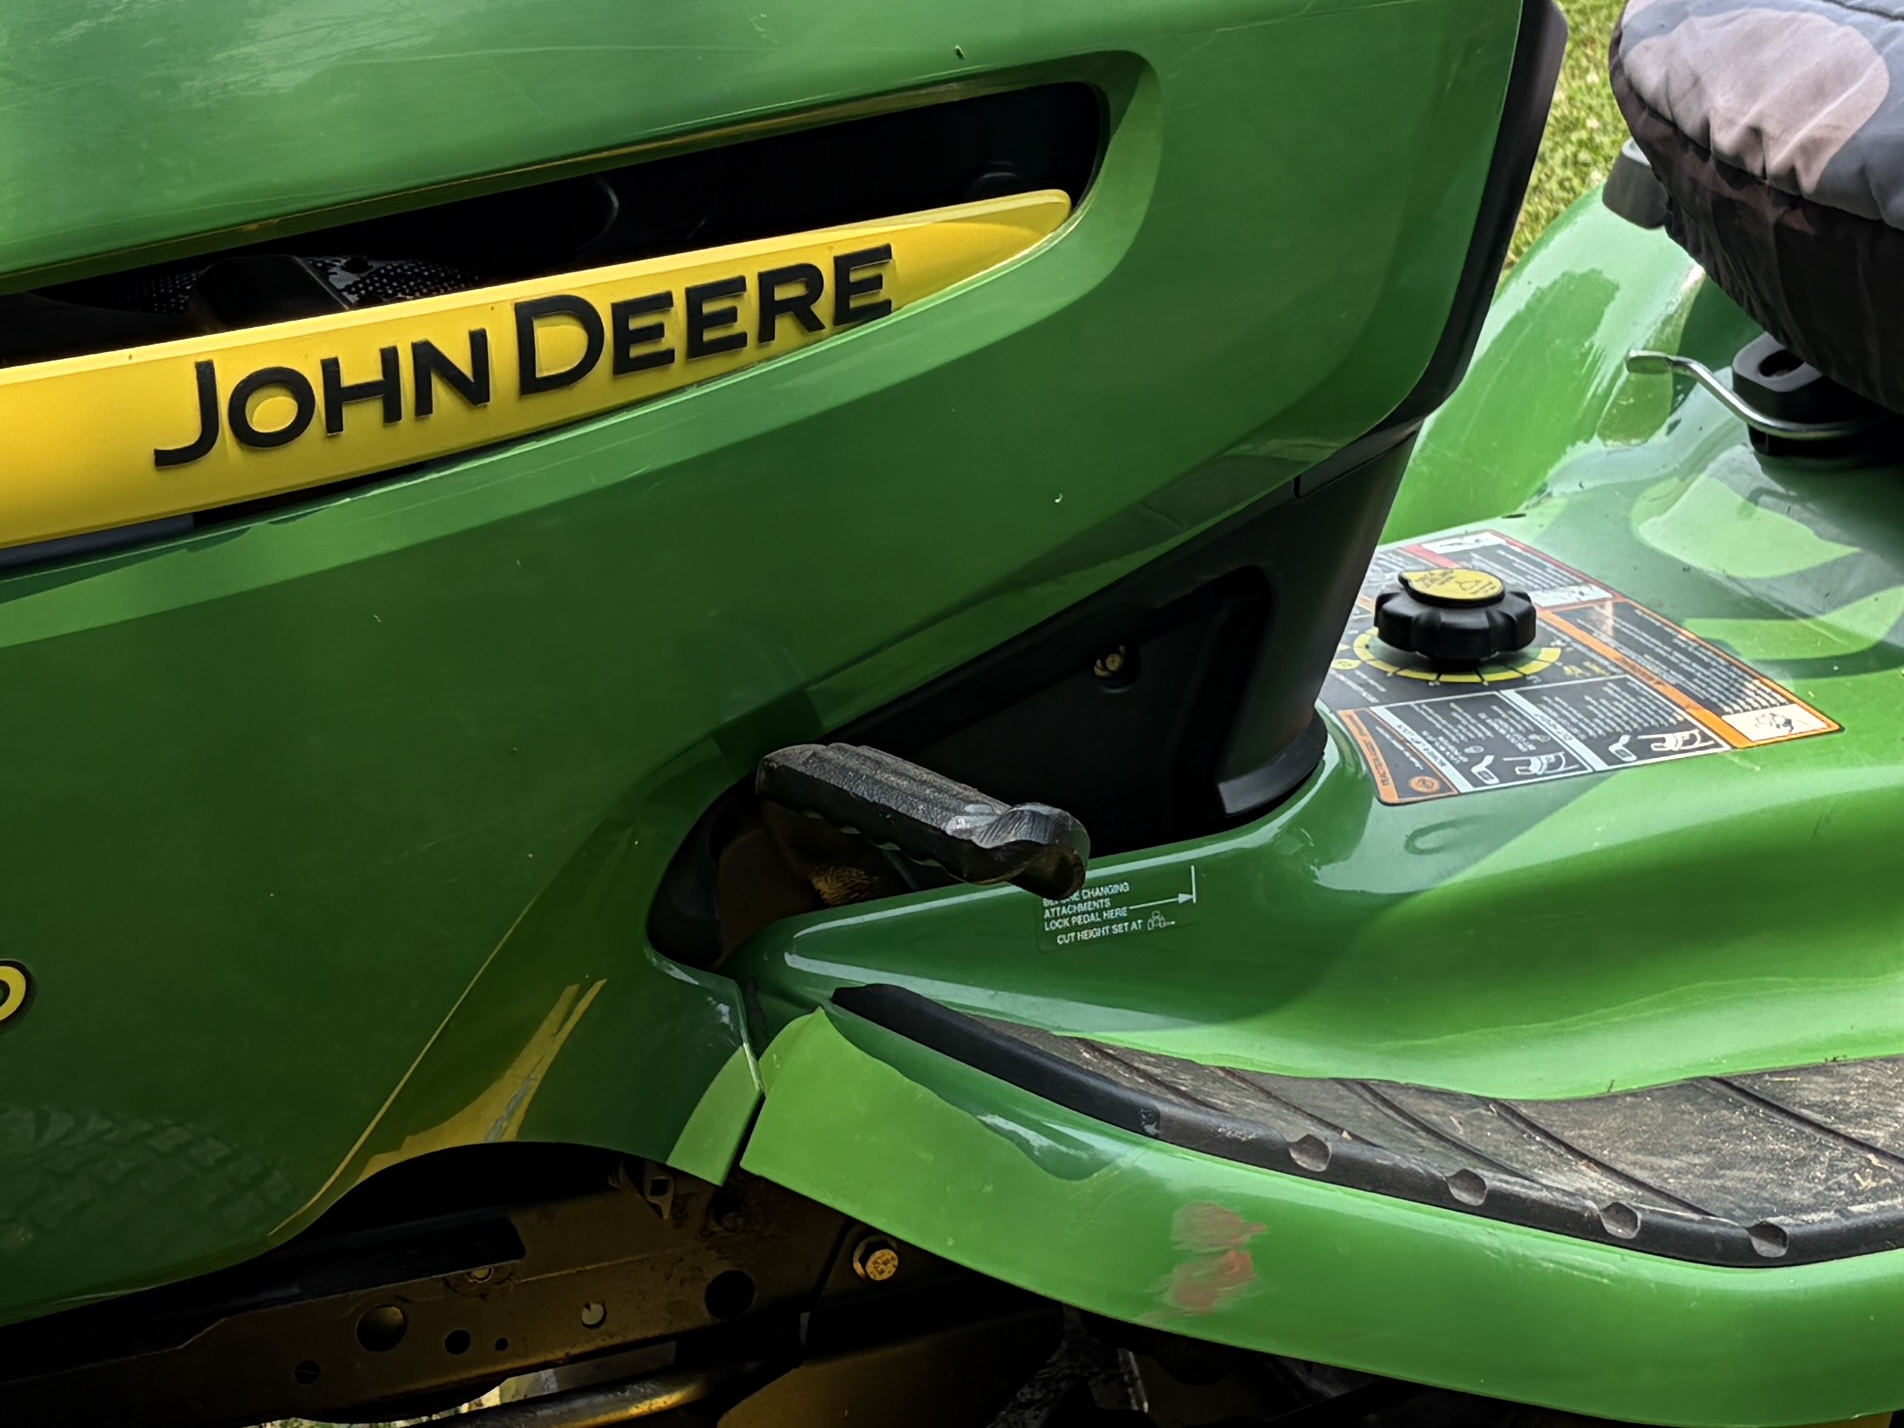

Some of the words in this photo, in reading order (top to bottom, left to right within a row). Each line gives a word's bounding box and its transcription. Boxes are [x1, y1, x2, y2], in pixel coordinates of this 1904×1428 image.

[153, 328, 492, 468] JOHN
[514, 243, 895, 397] DEERE
[1082, 882, 1130, 900] CHANGING
[1043, 898, 1111, 919] ATTACHMENTS
[1044, 915, 1070, 932] LOCK
[1071, 911, 1102, 927] PEDAL
[1103, 906, 1128, 921] HERE
[1057, 931, 1077, 946] CUT
[1077, 925, 1110, 942] HEIGHT
[1112, 921, 1130, 935] SET
[1130, 919, 1143, 932] AT
